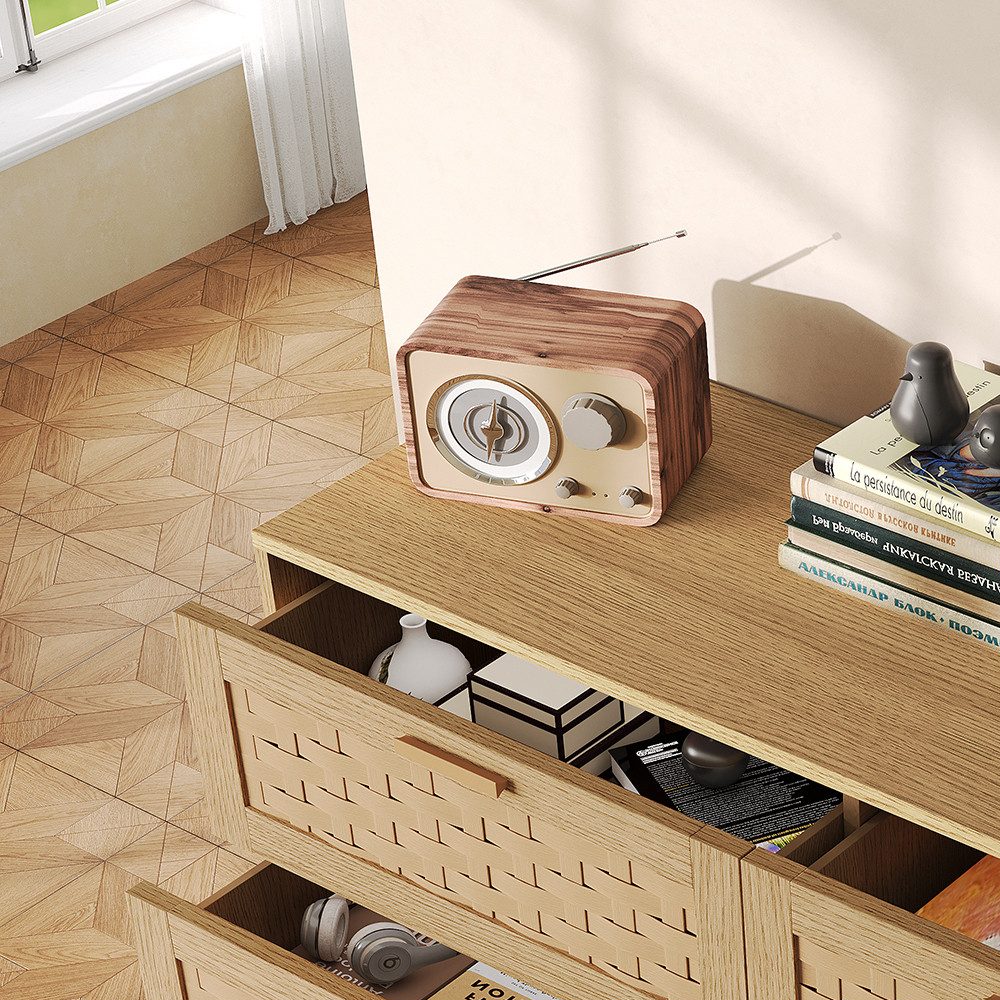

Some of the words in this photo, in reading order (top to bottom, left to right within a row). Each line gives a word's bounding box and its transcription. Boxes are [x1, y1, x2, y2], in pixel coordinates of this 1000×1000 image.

[850, 461, 861, 482] La
[863, 475, 917, 506] persistance
[919, 490, 932, 512] du
[934, 496, 964, 524] destin
[798, 561, 889, 602] АЛЕКСАНДР
[894, 598, 938, 623] БЛОК
